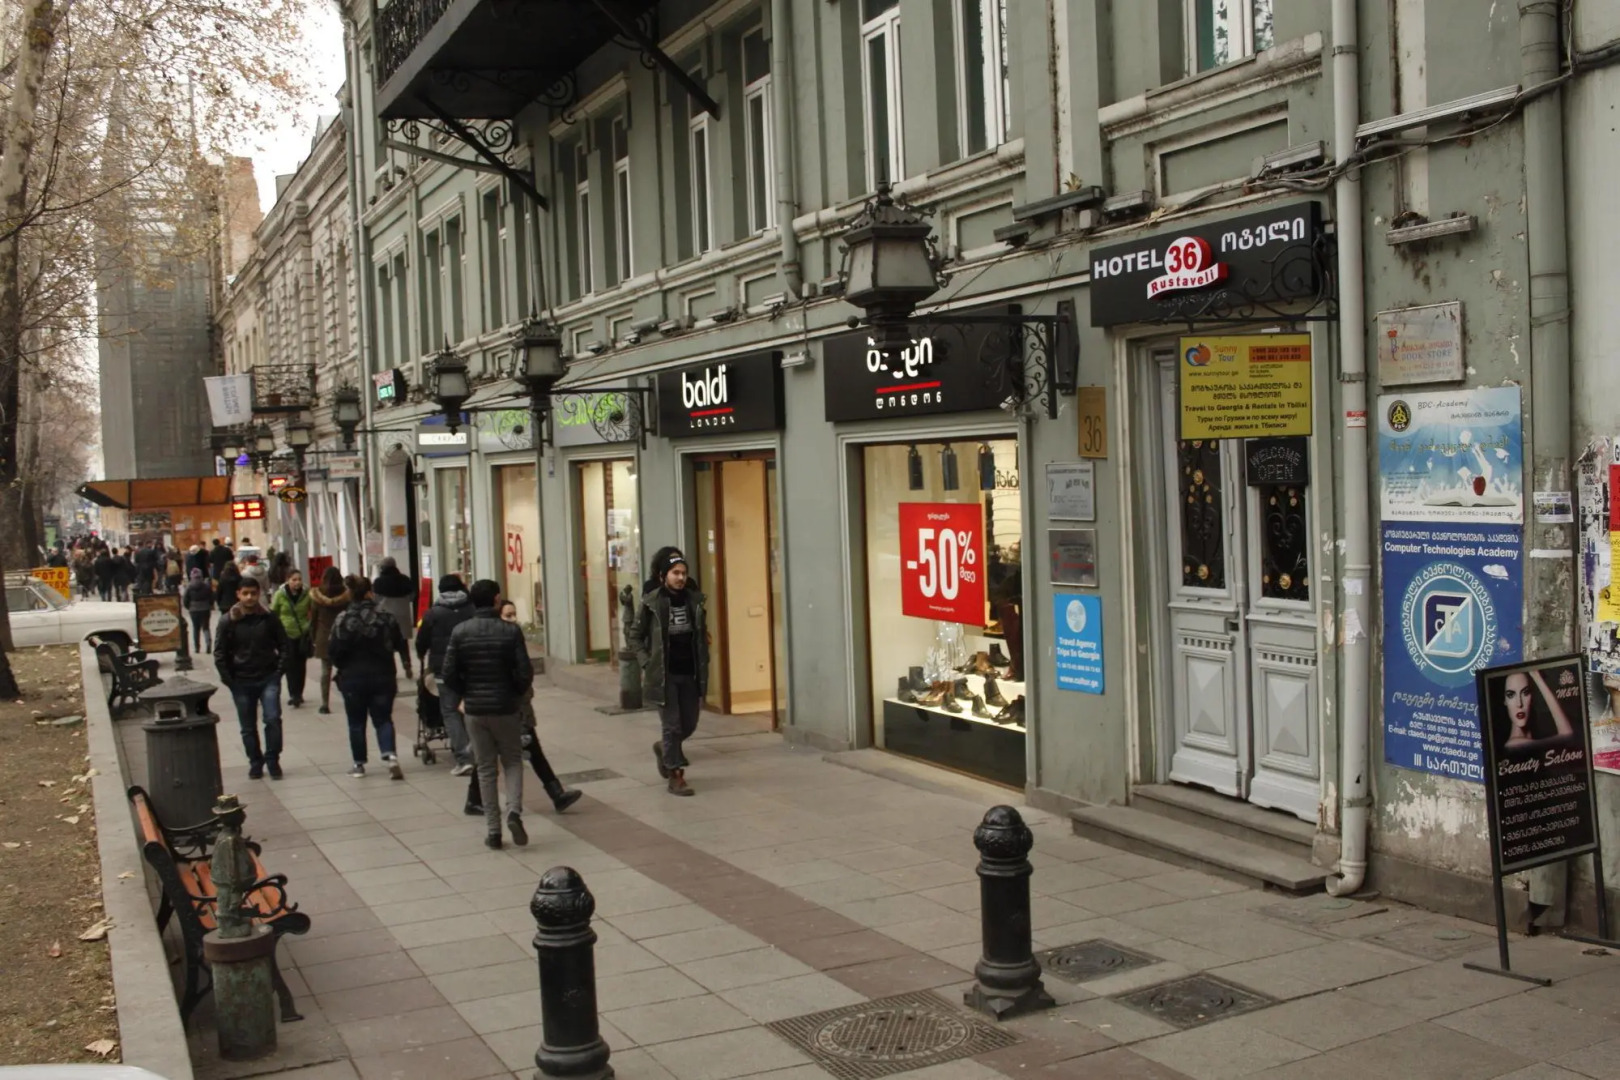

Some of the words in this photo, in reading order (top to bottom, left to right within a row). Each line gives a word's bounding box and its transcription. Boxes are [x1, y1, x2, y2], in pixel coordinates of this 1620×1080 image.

[1221, 217, 1305, 252] ოტელი
[1094, 248, 1165, 279] HOTEL
[1168, 241, 1197, 274] 36
[1151, 268, 1215, 294] Rustaveli
[1214, 345, 1238, 354] Sunny
[1219, 354, 1235, 362] Tour
[1427, 349, 1452, 358] STORE
[682, 363, 728, 409] baldi
[1216, 403, 1243, 412] Georgia
[690, 415, 735, 428] LONDON
[1197, 415, 1213, 423] Туры
[1084, 415, 1102, 452] 36
[1208, 424, 1232, 432] Аренда
[1249, 446, 1301, 469] WELCOME
[1257, 464, 1294, 481] OPEN
[507, 532, 523, 573] 50
[1384, 541, 1421, 554] Computer
[1422, 543, 1476, 558] Technologies
[1477, 546, 1519, 560] Academy
[907, 528, 976, 600] -50%
[1058, 637, 1076, 646] Travel
[1076, 639, 1097, 650] Agency
[1078, 650, 1100, 661] Georgia
[1413, 753, 1422, 767] III
[1422, 743, 1479, 761] www.ctaedu.ge
[1498, 757, 1540, 776] Beauty
[1543, 749, 1584, 767] Saloon
